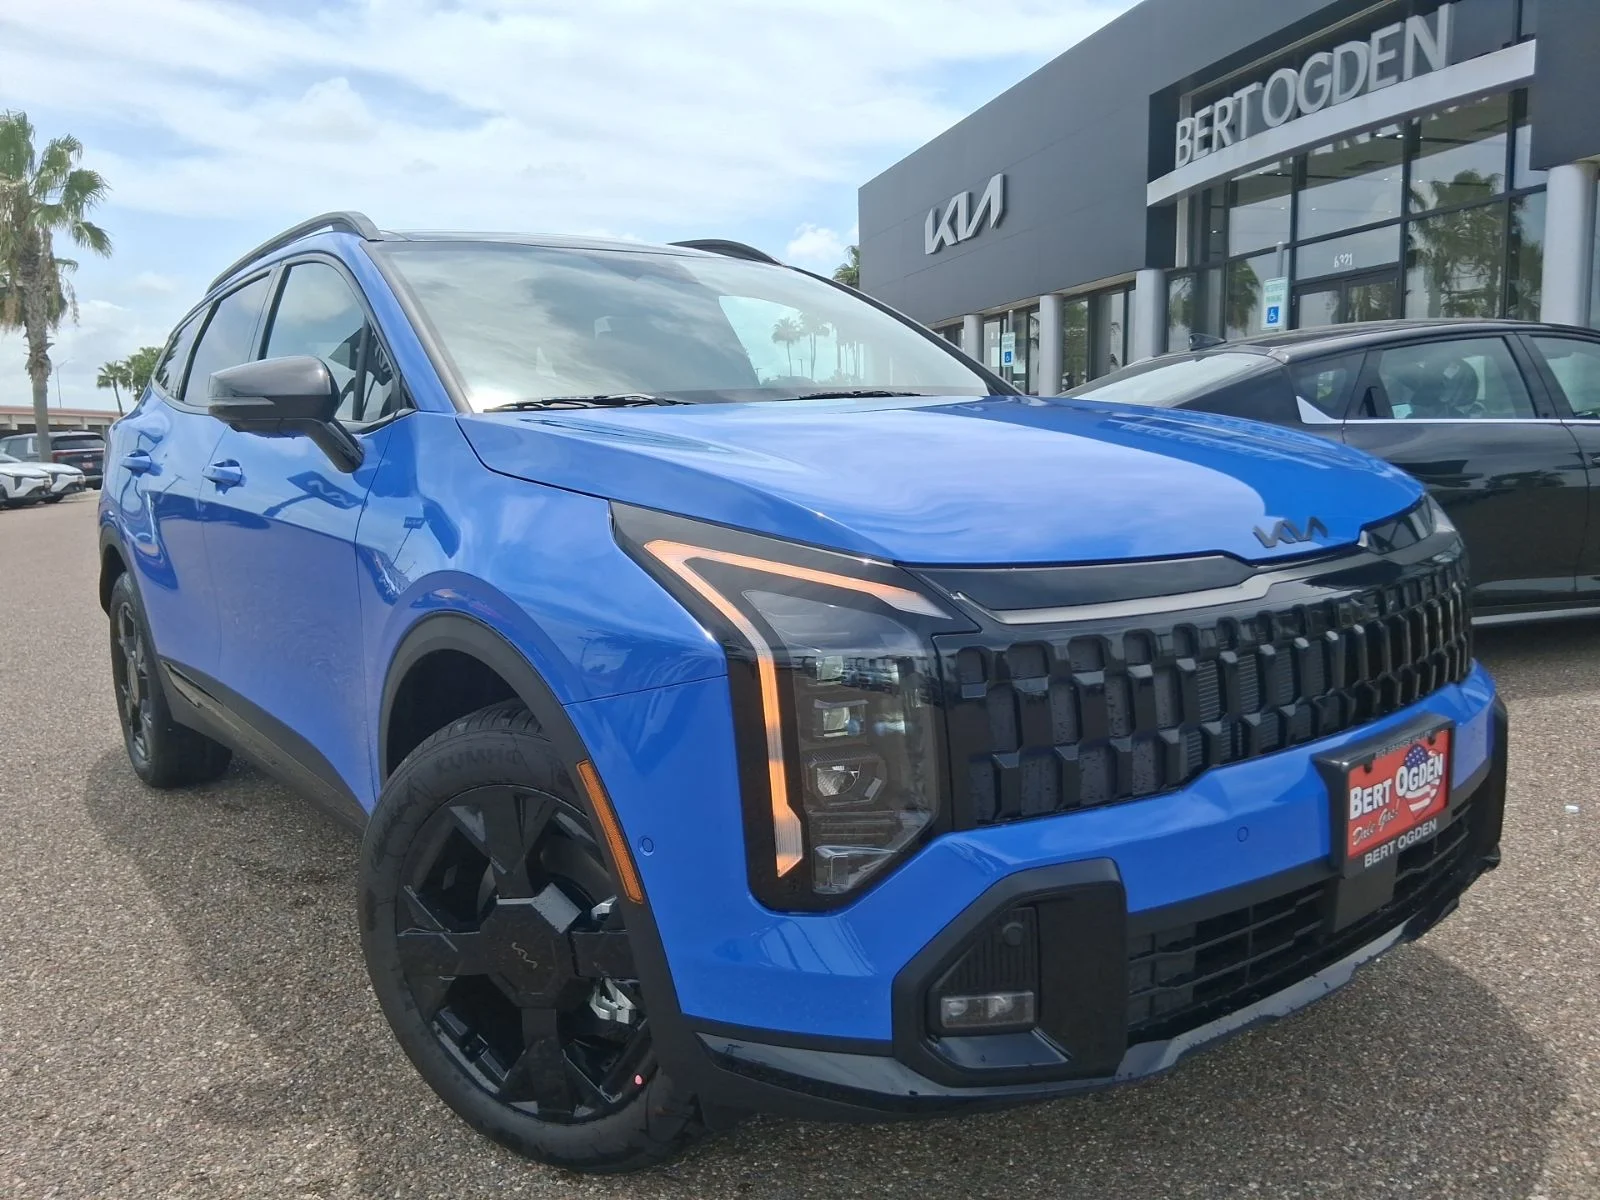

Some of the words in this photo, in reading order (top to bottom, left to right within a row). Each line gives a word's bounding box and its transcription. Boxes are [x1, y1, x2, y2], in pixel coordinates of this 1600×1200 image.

[1175, 82, 1263, 169] BERT
[1262, 3, 1453, 127] OGDEN
[924, 172, 1005, 255] KIA
[1252, 516, 1328, 548] KIA
[1349, 778, 1392, 820] BERT
[1395, 752, 1443, 797] OGDEN
[1364, 839, 1398, 868] BERT
[1397, 818, 1437, 849] OGDEN
